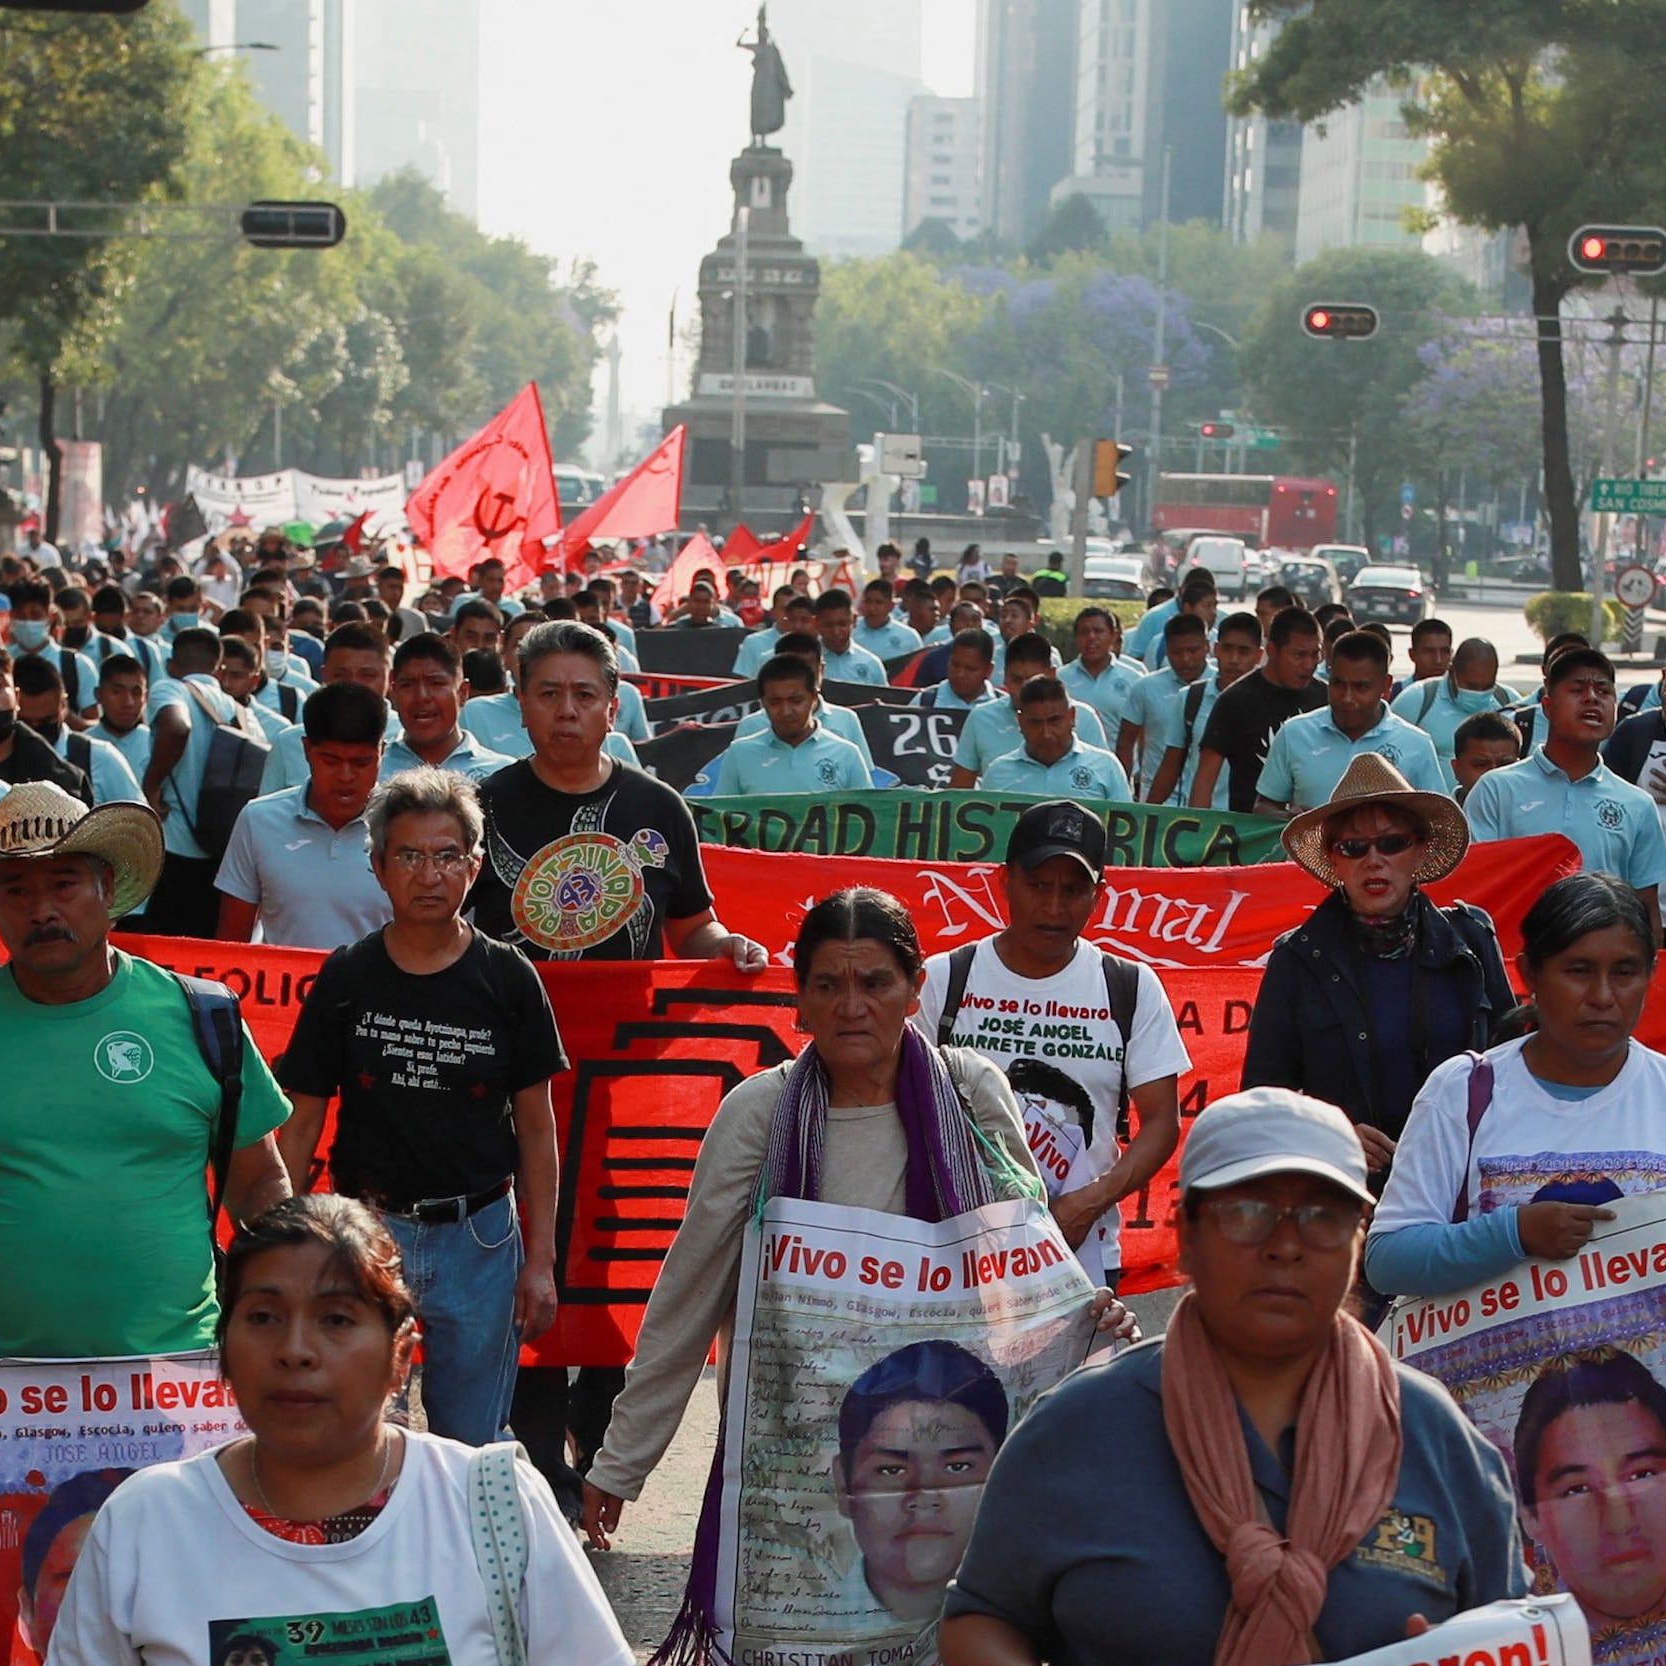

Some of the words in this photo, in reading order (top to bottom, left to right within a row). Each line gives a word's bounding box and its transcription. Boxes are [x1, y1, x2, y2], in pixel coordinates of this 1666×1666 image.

[1597, 498, 1624, 510] SAN
[889, 714, 957, 758] 26
[897, 800, 1241, 868] HISTRICA
[559, 875, 597, 908] 43
[997, 998, 1019, 1014] se
[1022, 998, 1043, 1017] lo
[978, 1016, 1025, 1036] JOSÉ
[1029, 1022, 1094, 1042] ANGEL
[762, 1232, 848, 1282] ¡Vivo
[858, 1256, 905, 1290] se
[917, 1257, 952, 1293] lo
[1397, 1297, 1471, 1358] ¡Vivo
[1480, 1280, 1520, 1317] se
[1530, 1265, 1569, 1301] lo
[20, 1384, 68, 1414] se
[80, 1375, 118, 1412] lo
[285, 1619, 325, 1646] 39
[410, 1605, 432, 1627] 43
